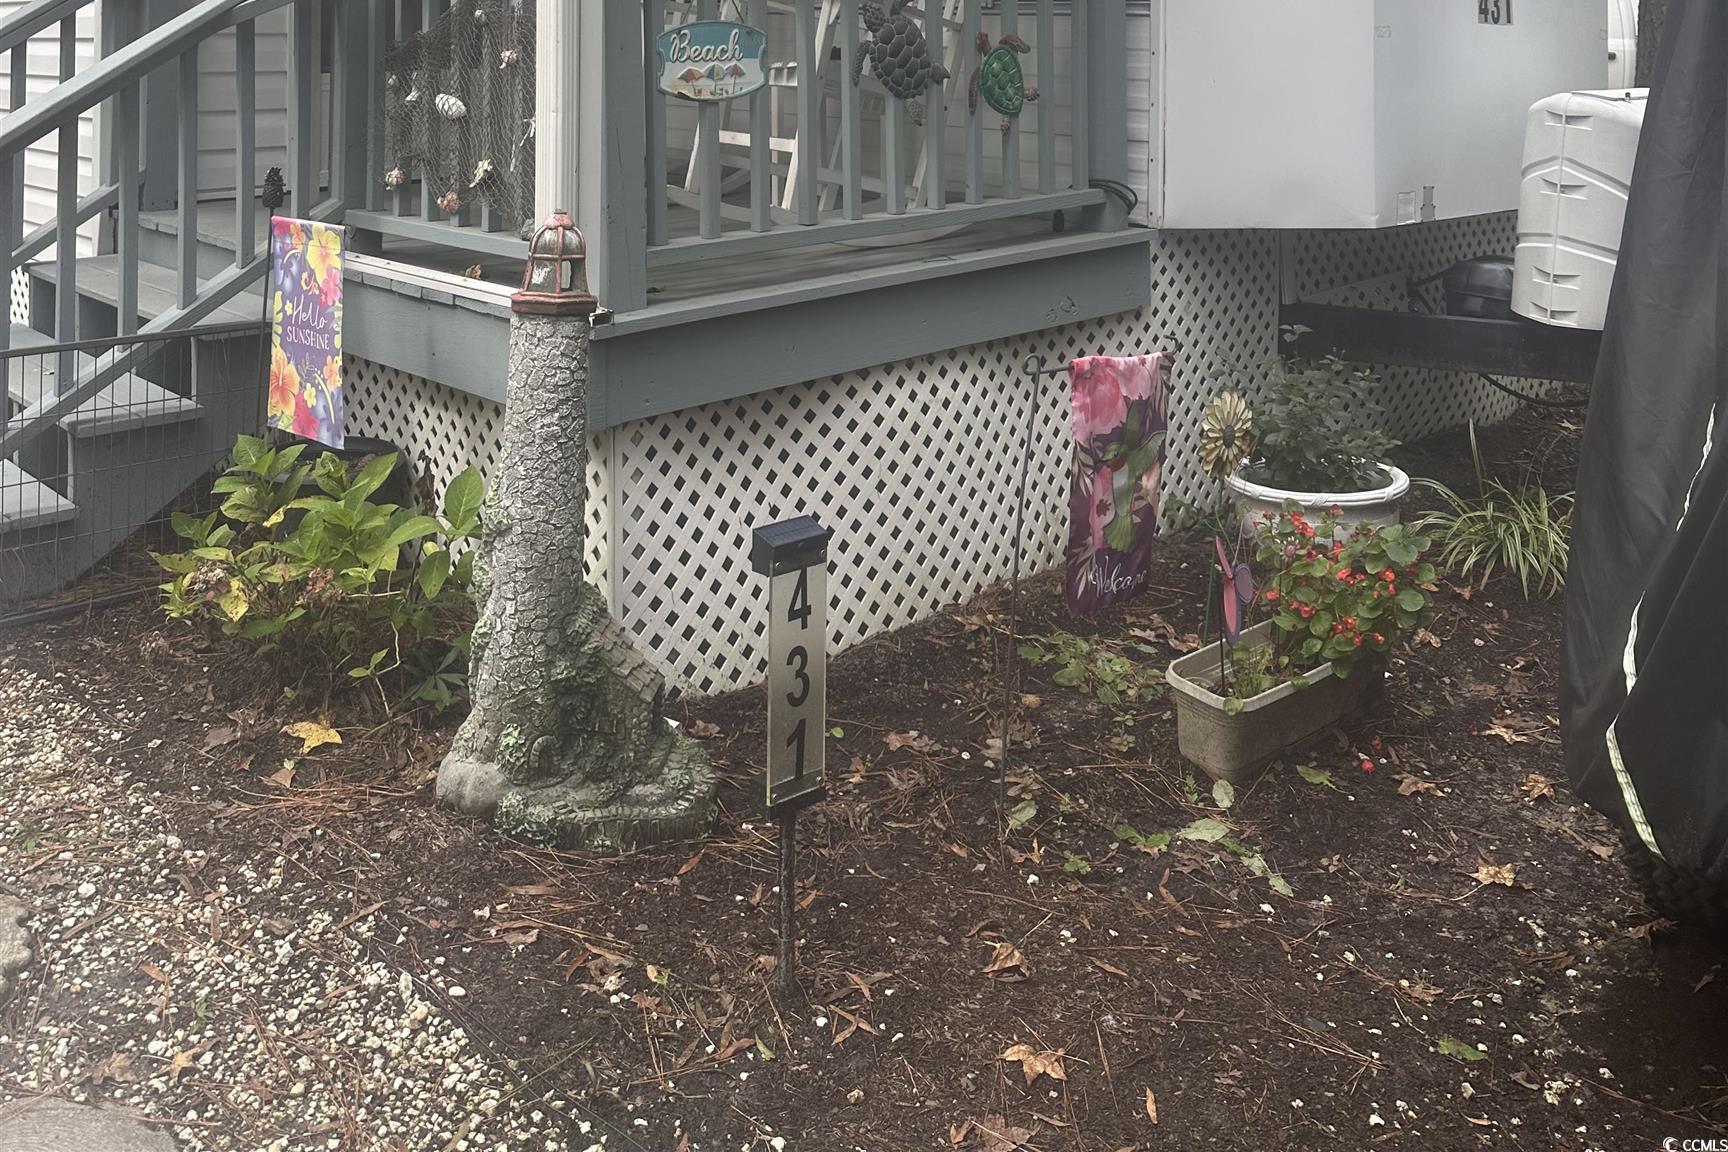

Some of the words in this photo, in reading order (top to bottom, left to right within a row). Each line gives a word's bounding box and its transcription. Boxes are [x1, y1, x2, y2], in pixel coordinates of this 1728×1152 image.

[670, 28, 744, 63] Beach
[292, 294, 327, 329] Hello
[286, 326, 330, 350] SUNSHINE
